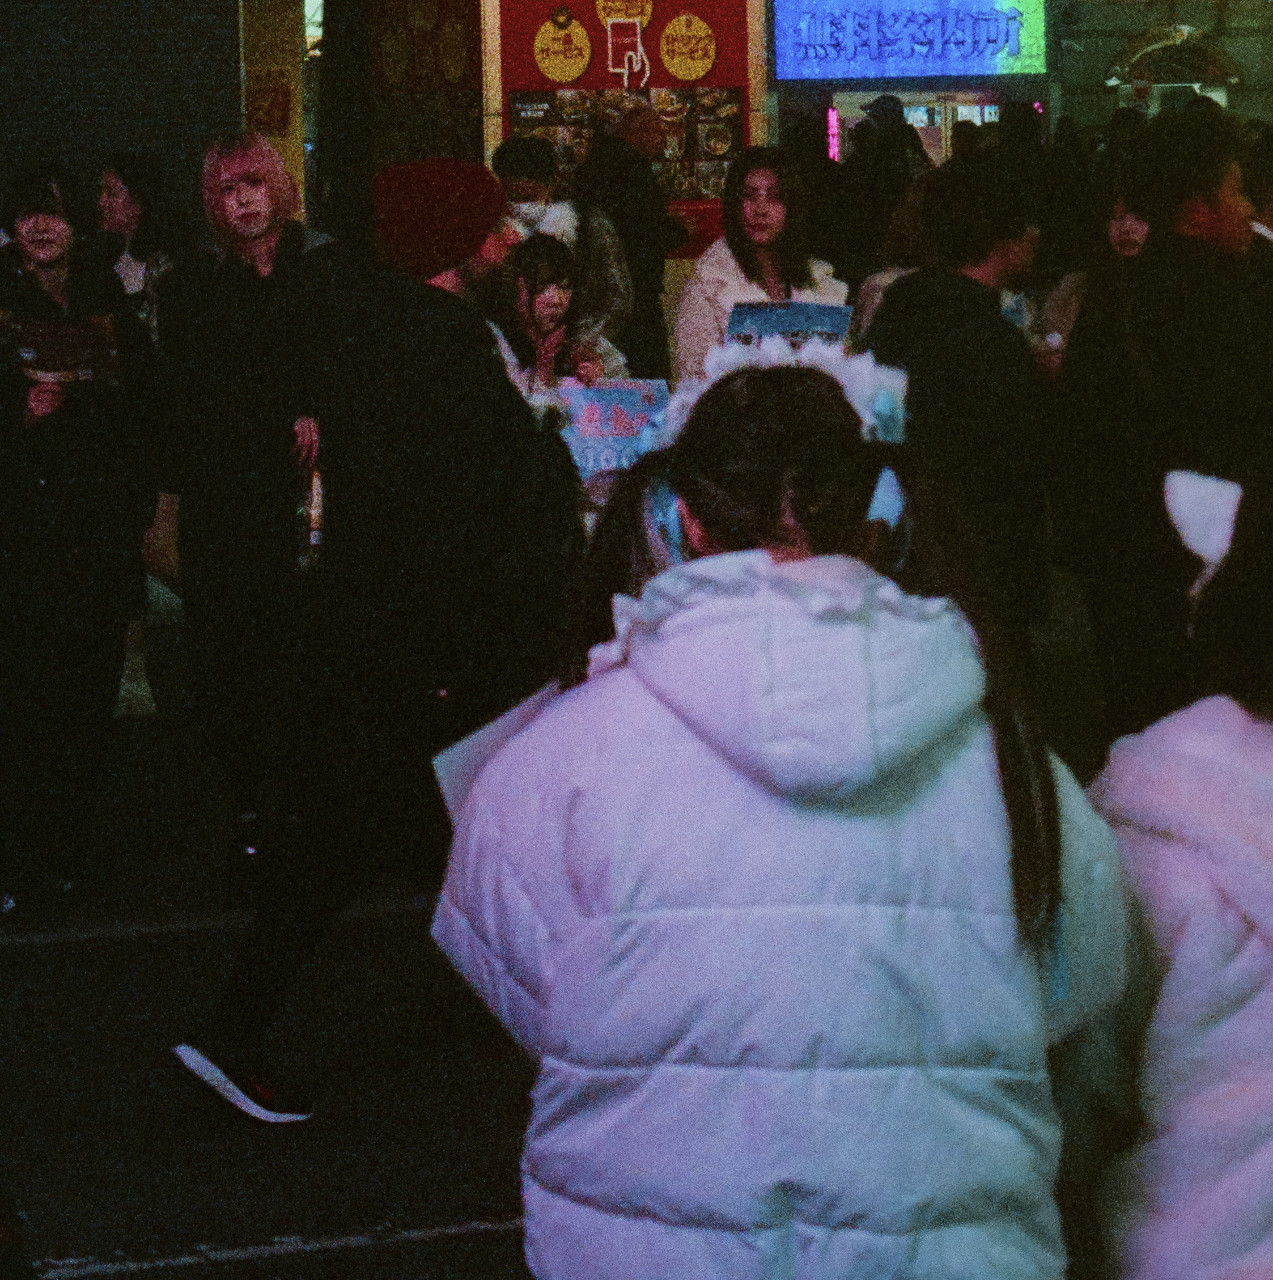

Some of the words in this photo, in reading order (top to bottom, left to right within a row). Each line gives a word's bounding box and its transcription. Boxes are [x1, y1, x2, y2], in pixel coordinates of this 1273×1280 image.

[796, 7, 1023, 60] 無料案内所
